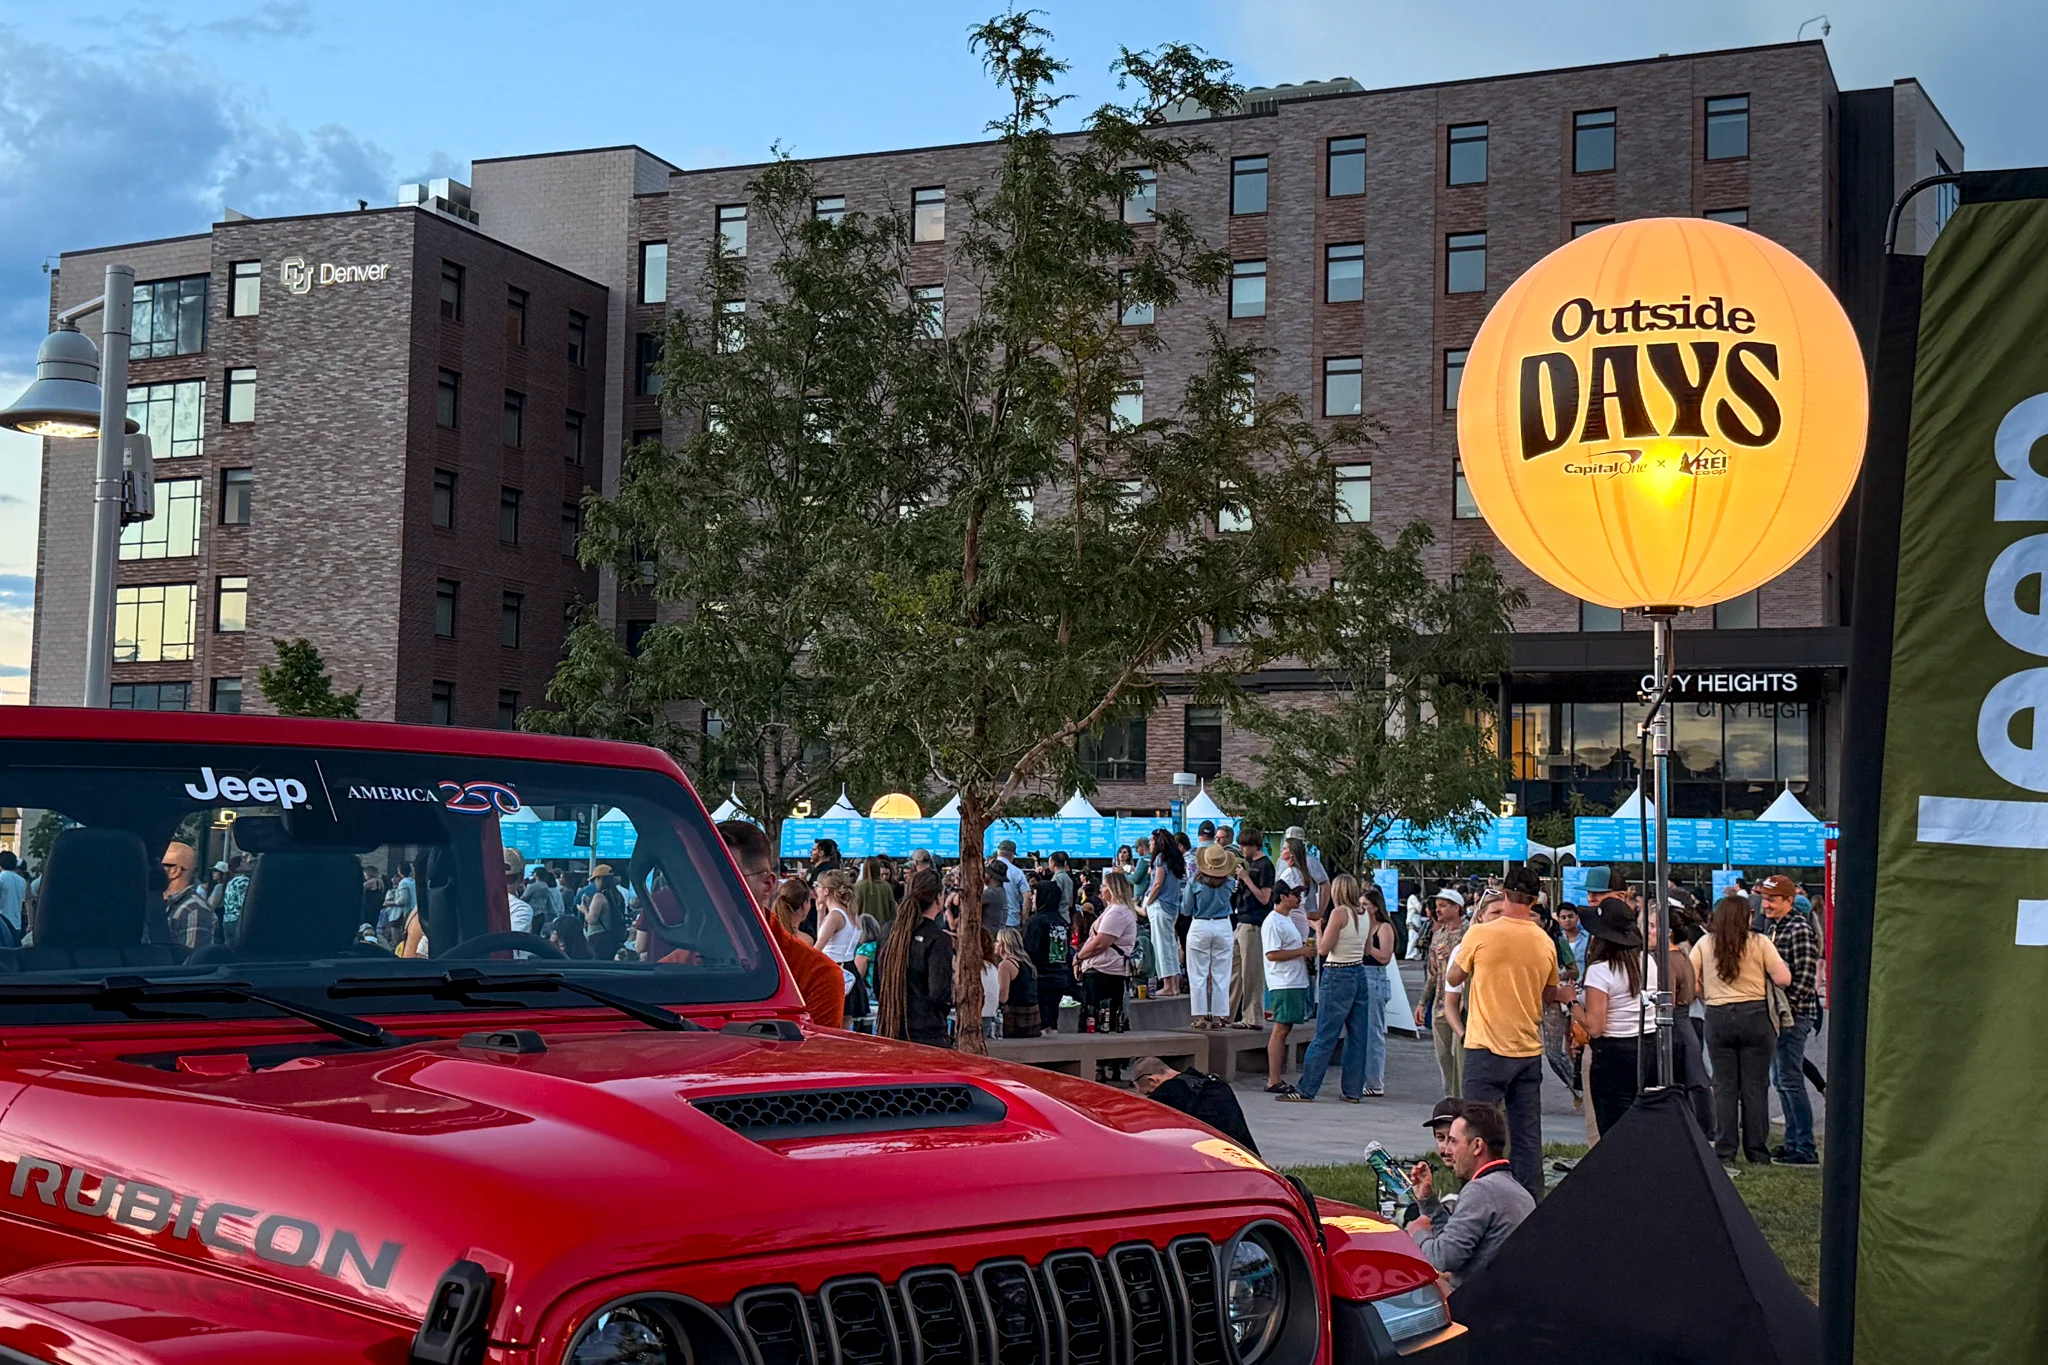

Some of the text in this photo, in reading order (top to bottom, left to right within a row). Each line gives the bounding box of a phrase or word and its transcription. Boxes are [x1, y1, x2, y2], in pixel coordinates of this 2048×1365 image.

[320, 263, 391, 284] Denver
[1551, 295, 1756, 343] Outside
[1519, 341, 1782, 461] DAYS
[1640, 673, 1799, 693] CY HEIGHTS
[184, 767, 521, 815] Jeep AMERICA 250
[9, 1155, 405, 1292] RUBICON
